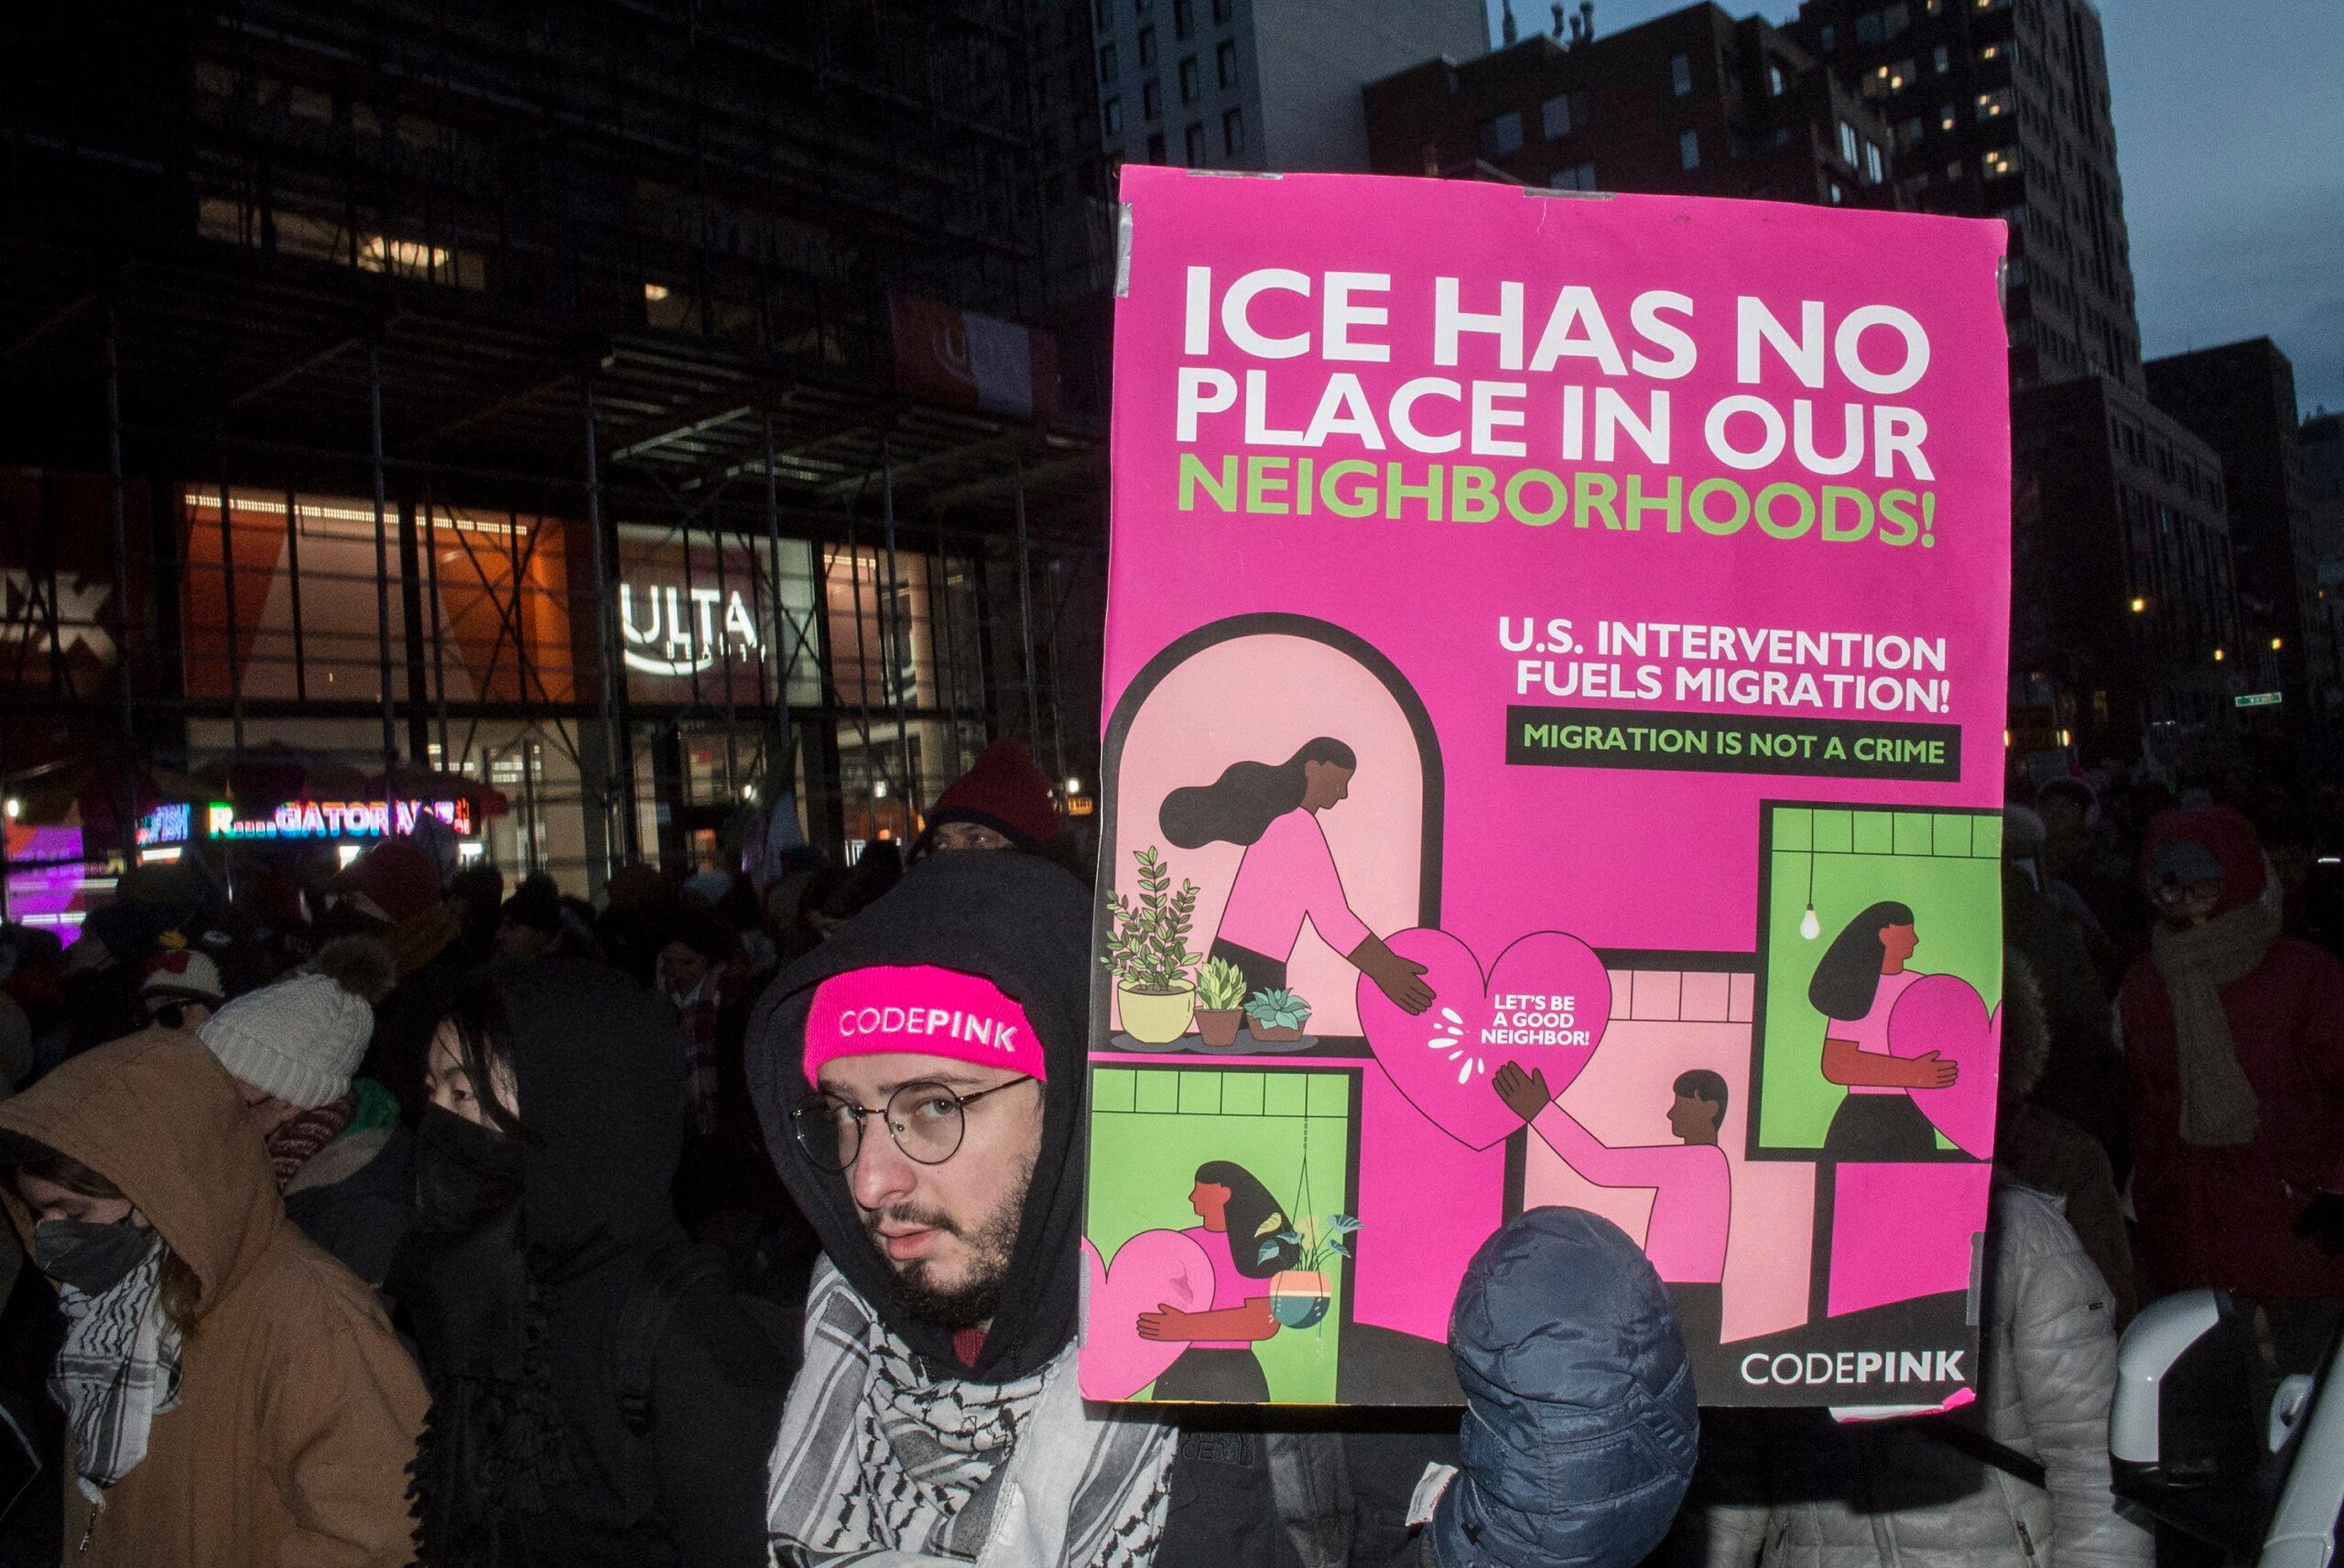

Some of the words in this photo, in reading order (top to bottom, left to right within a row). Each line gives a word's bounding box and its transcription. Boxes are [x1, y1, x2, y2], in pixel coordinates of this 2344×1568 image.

[1184, 265, 1392, 364] ICE
[1433, 276, 1698, 380] HAS
[1736, 294, 1932, 395] NO
[1176, 366, 1527, 459] PLACE
[1562, 384, 1672, 465] IN
[1704, 394, 1937, 481] OUR
[1177, 453, 1936, 548] NEIGHBORHOODS!
[620, 583, 758, 649] ULTA
[1499, 616, 1584, 655] U.S.
[1598, 620, 1947, 673] INTERVENTION
[1516, 659, 1663, 701] FUELS
[1676, 665, 1951, 715] MIGRATION!
[1523, 723, 1709, 755] MIGRATION
[1717, 730, 1742, 756] IS
[1749, 732, 1818, 759] NOT
[1822, 735, 1848, 761] A
[1852, 737, 1945, 765] CRIME
[1492, 1011, 1509, 1027] A
[1512, 1011, 1575, 1029] GOOD
[1494, 994, 1546, 1011] LET'S
[1550, 995, 1575, 1011] BE
[840, 1007, 1017, 1052] CODEPINK
[1481, 1028, 1590, 1046] NEIGHBOR!
[1740, 1350, 1966, 1385] CODEPINK
